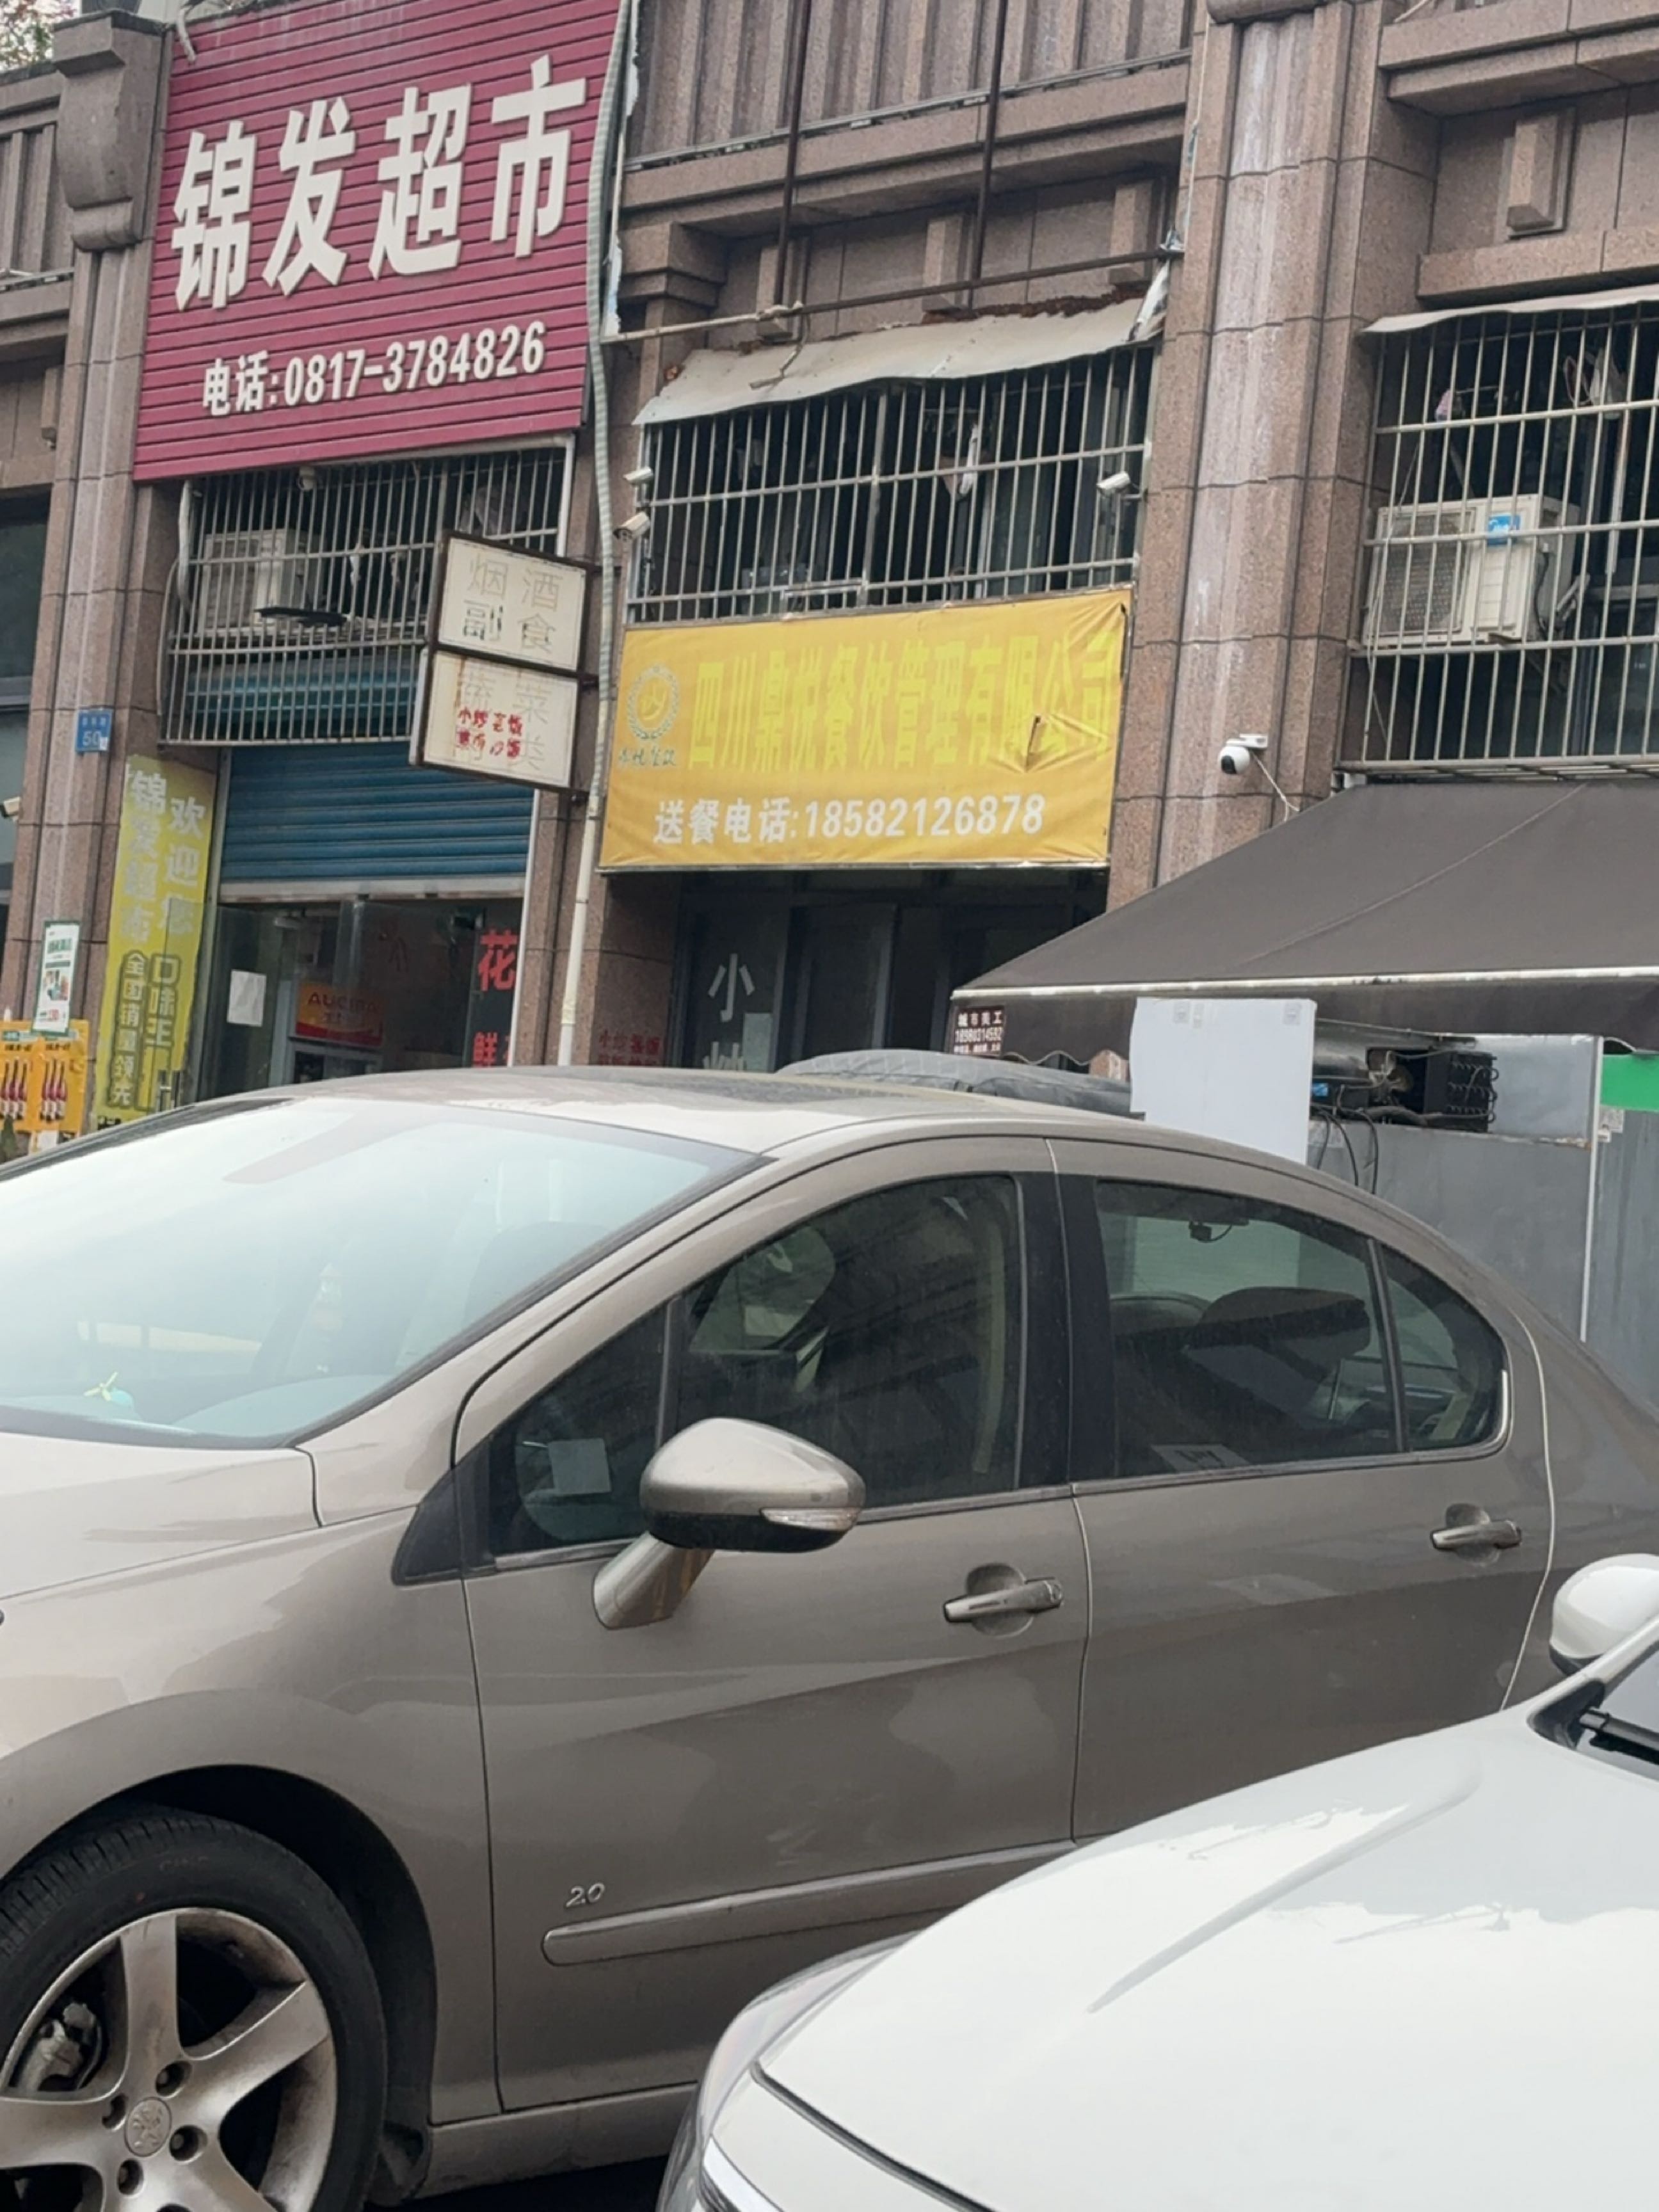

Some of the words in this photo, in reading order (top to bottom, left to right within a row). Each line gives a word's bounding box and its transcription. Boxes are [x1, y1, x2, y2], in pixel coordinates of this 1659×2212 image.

[171, 54, 586, 311] 锦发超市
[202, 320, 545, 416] 电话:0817-3784826
[467, 554, 563, 612] 烟酒
[653, 794, 1045, 844] 送餐电话:18582126878
[478, 929, 517, 991] 花
